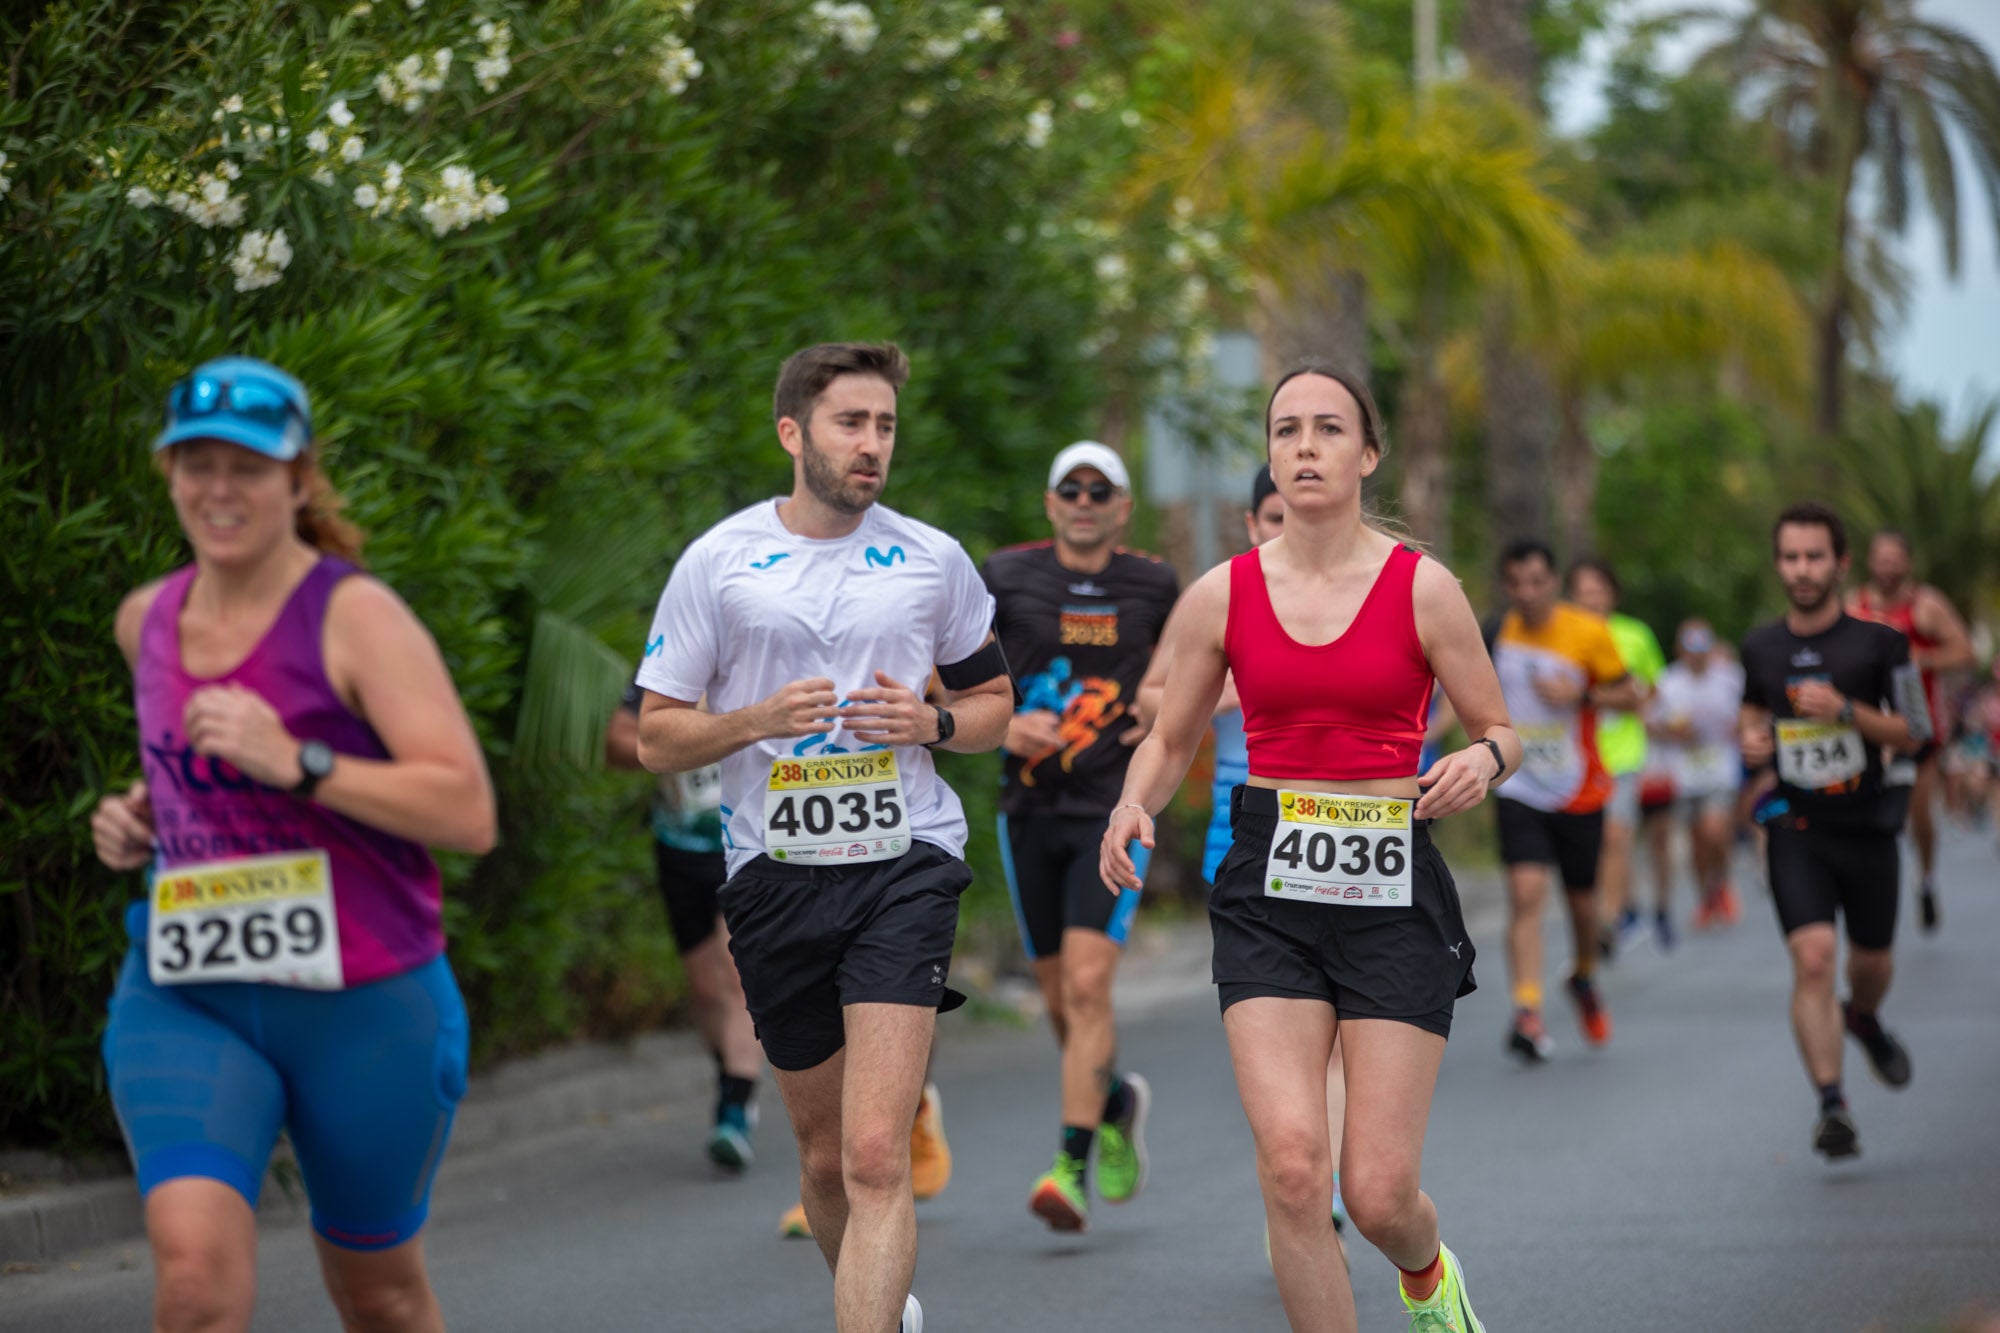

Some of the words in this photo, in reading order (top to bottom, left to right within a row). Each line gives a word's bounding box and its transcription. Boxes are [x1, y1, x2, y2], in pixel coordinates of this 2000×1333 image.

[806, 760, 832, 769] GRAN
[1788, 740, 1849, 771] 734
[781, 764, 802, 782] 38
[803, 763, 874, 782] FONDO
[1296, 798, 1316, 816] 38
[1319, 799, 1342, 807] GRAN
[770, 788, 902, 837] 4035
[1316, 805, 1381, 822] FONDO
[1273, 828, 1405, 877] 4036
[1284, 881, 1313, 890] Cruzcampo
[160, 906, 325, 973] 3269
